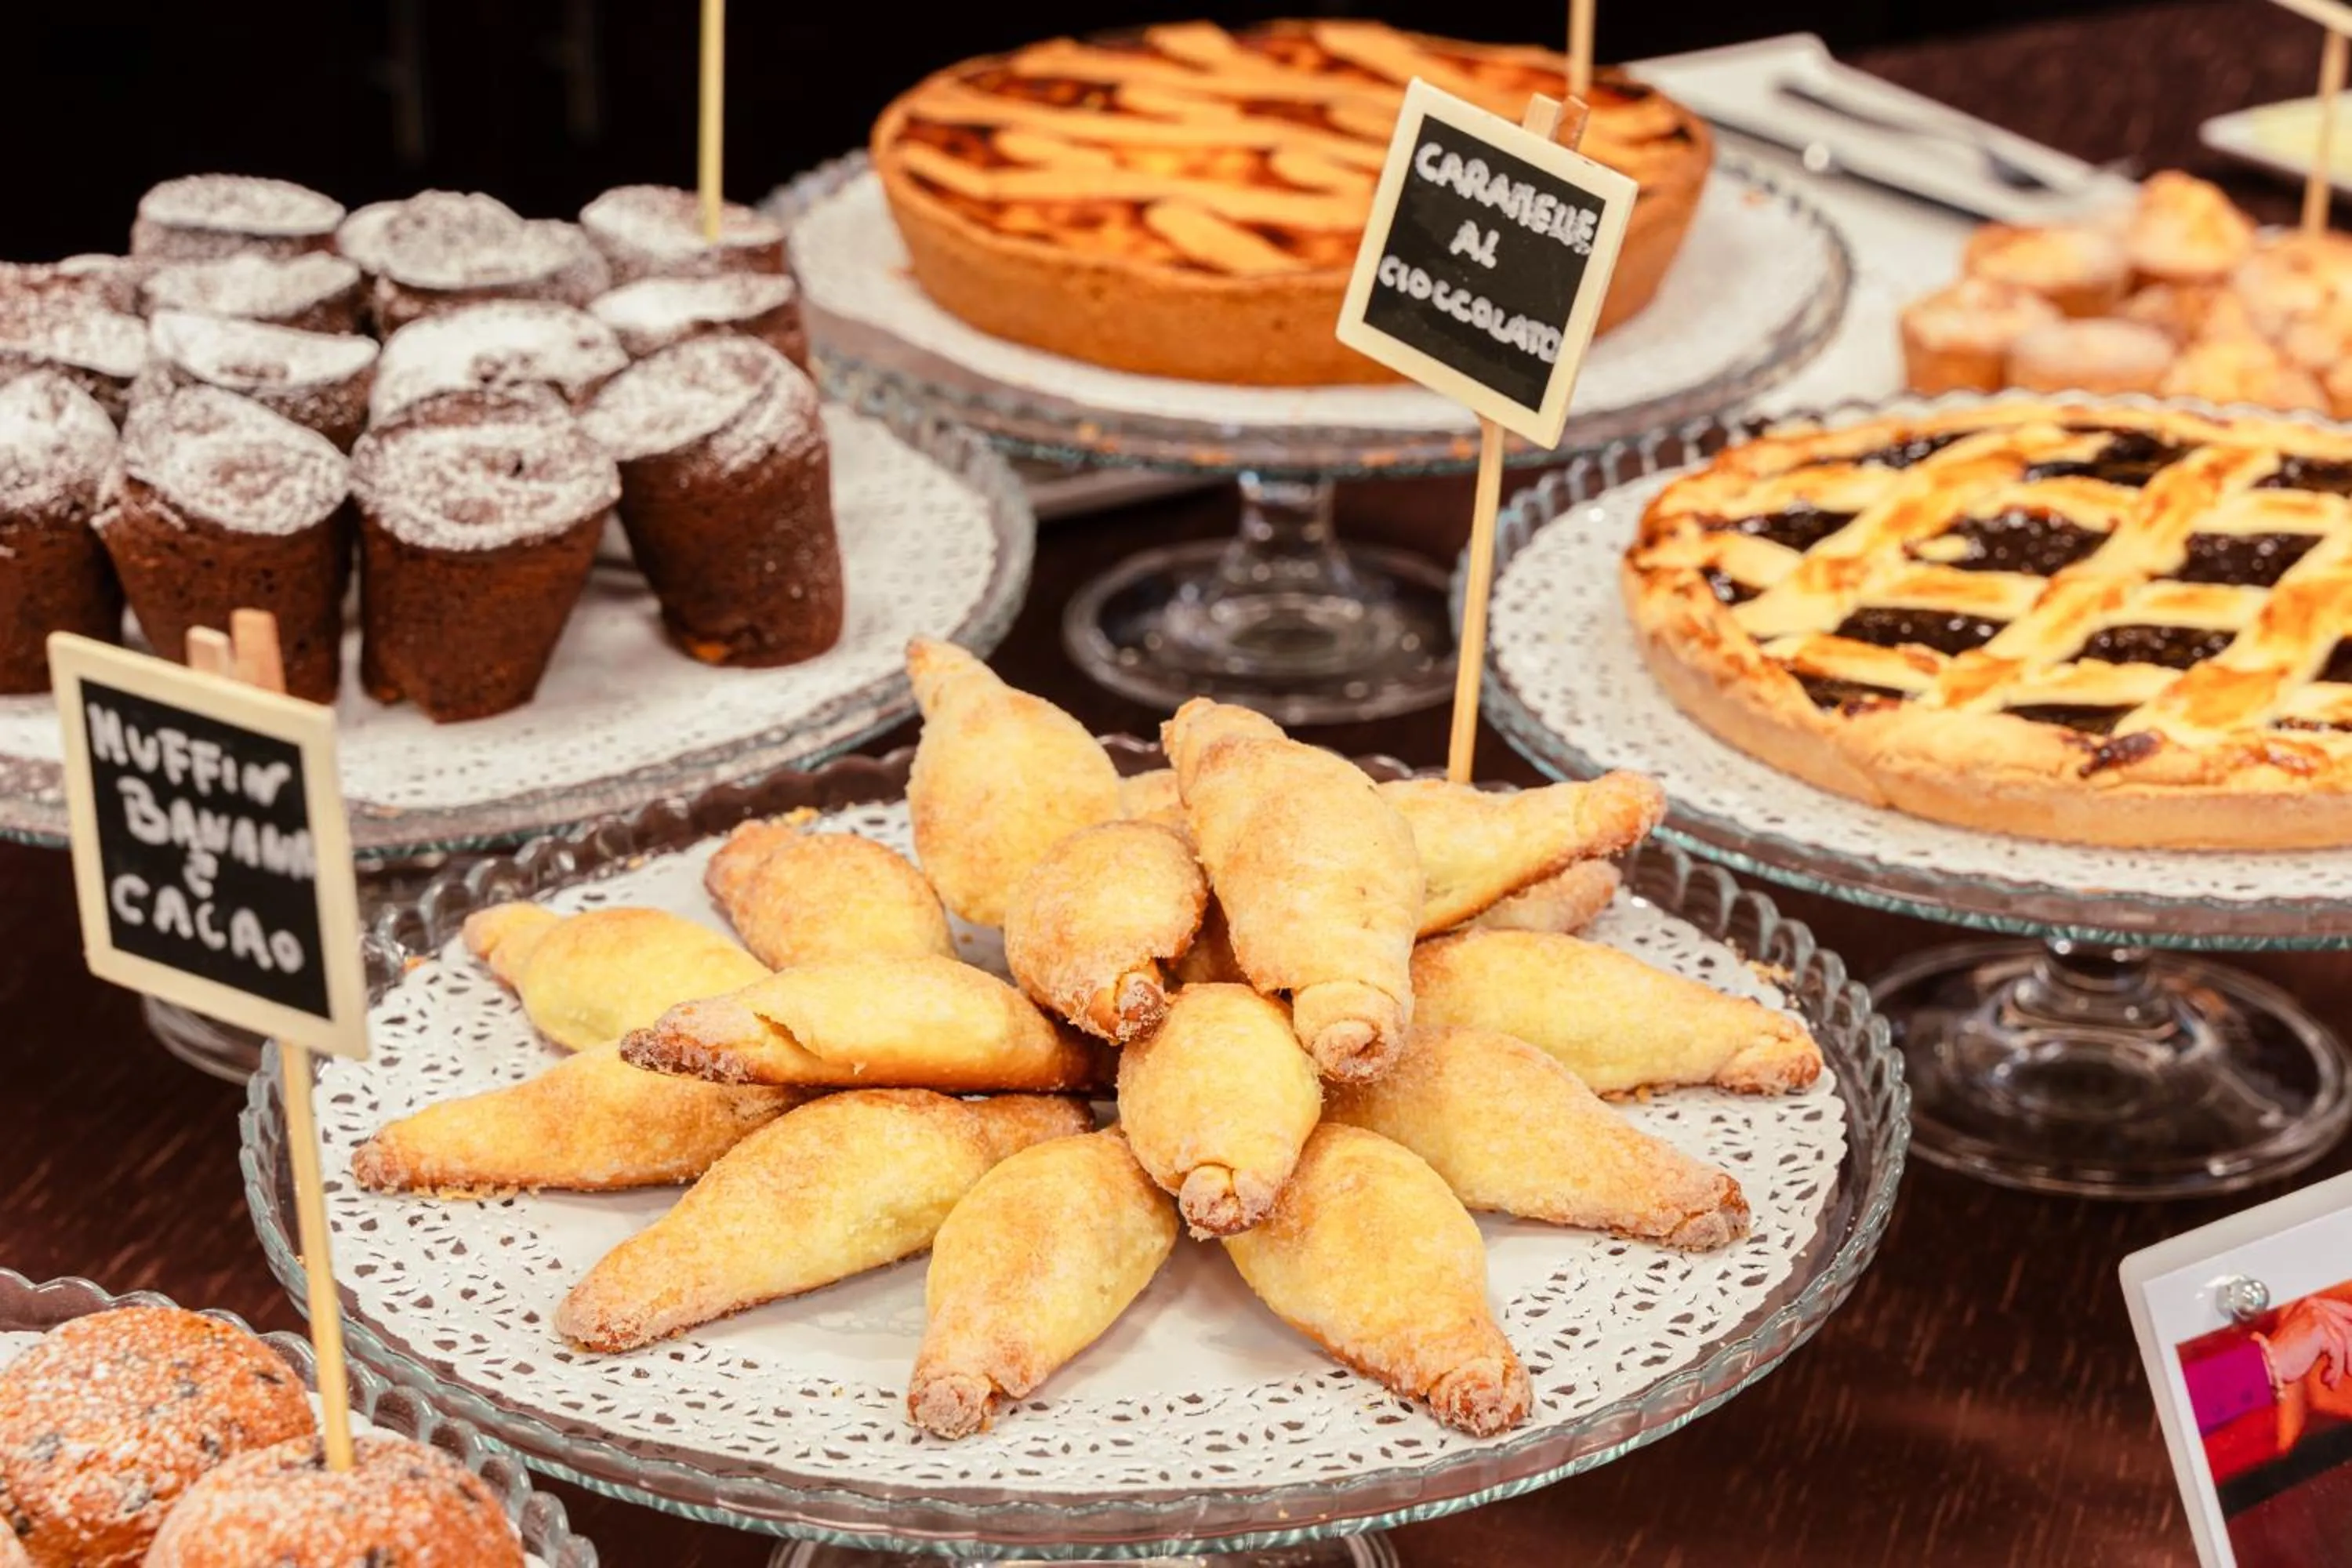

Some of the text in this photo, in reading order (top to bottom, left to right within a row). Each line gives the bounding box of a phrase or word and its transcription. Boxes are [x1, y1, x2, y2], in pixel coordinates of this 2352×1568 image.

[1449, 219, 1501, 269] AL
[1377, 254, 1563, 364] CIOCCOLATO
[87, 702, 292, 807] MUFFIN
[110, 873, 306, 975] CACAO
